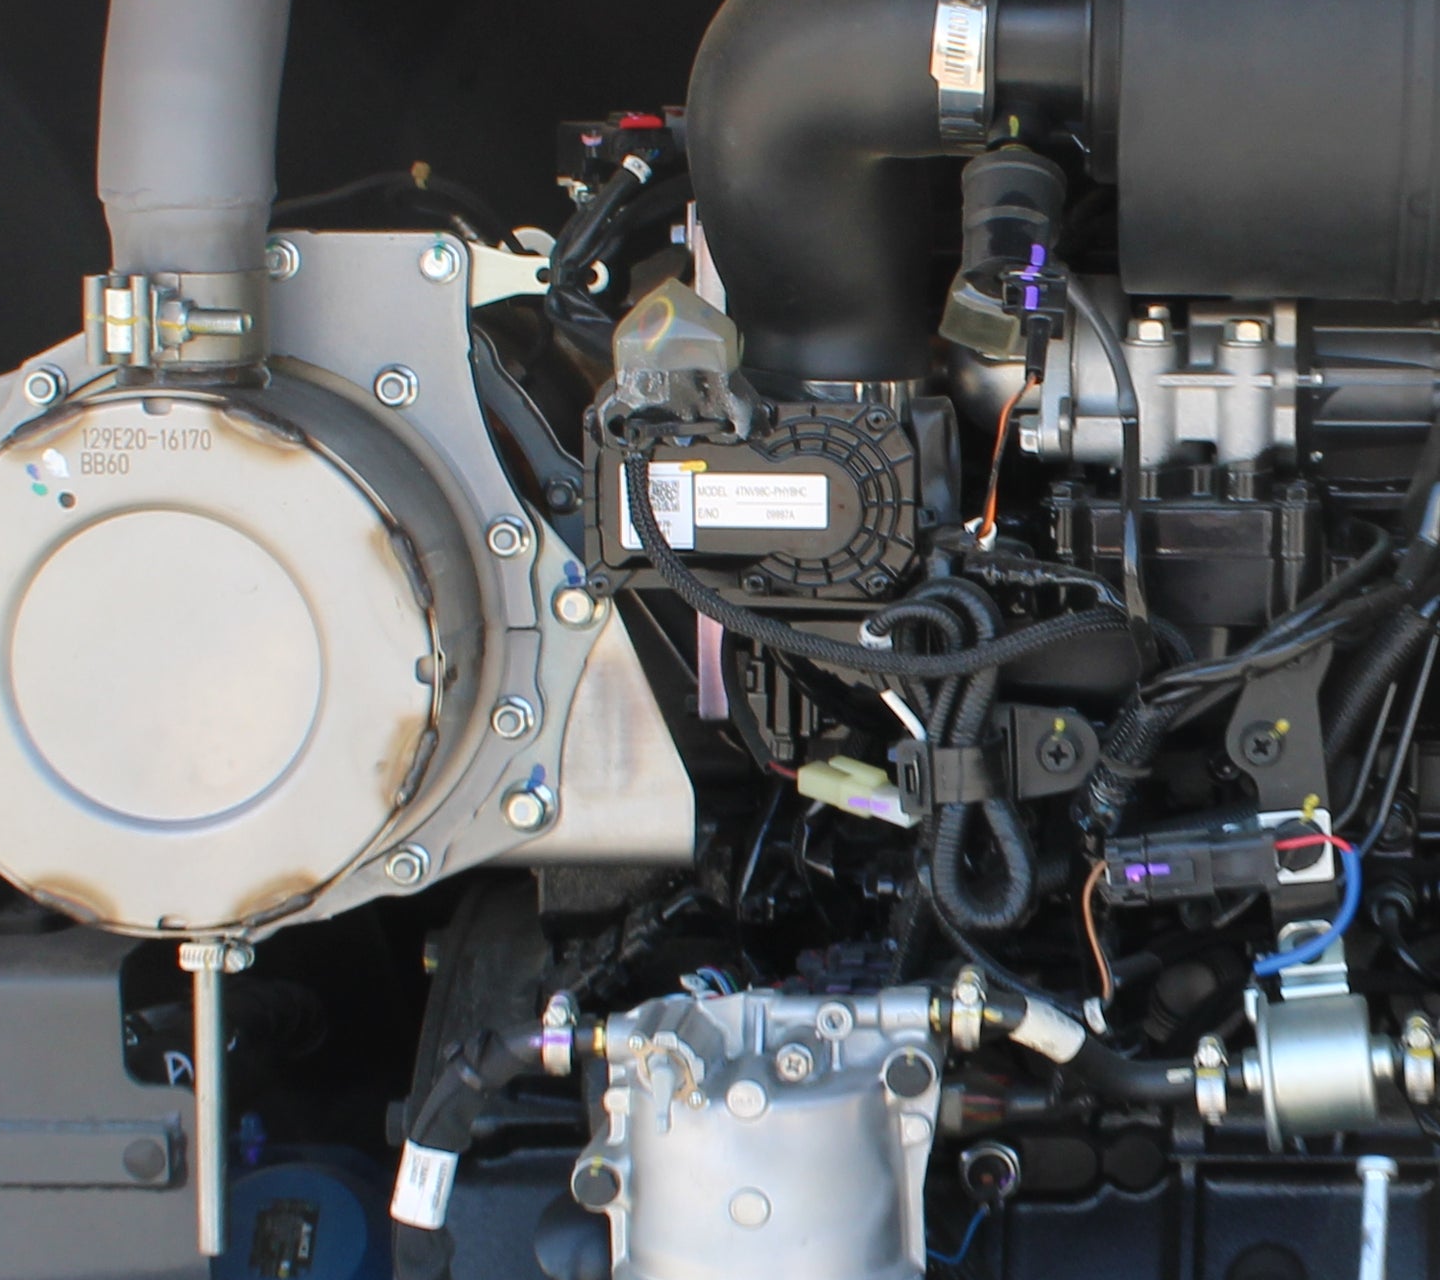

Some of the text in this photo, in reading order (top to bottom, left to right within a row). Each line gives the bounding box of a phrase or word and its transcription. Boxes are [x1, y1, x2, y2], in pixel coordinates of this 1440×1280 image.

[81, 427, 211, 451] 129E20-16170
[80, 452, 130, 475] BB60
[697, 485, 728, 498] MODEL
